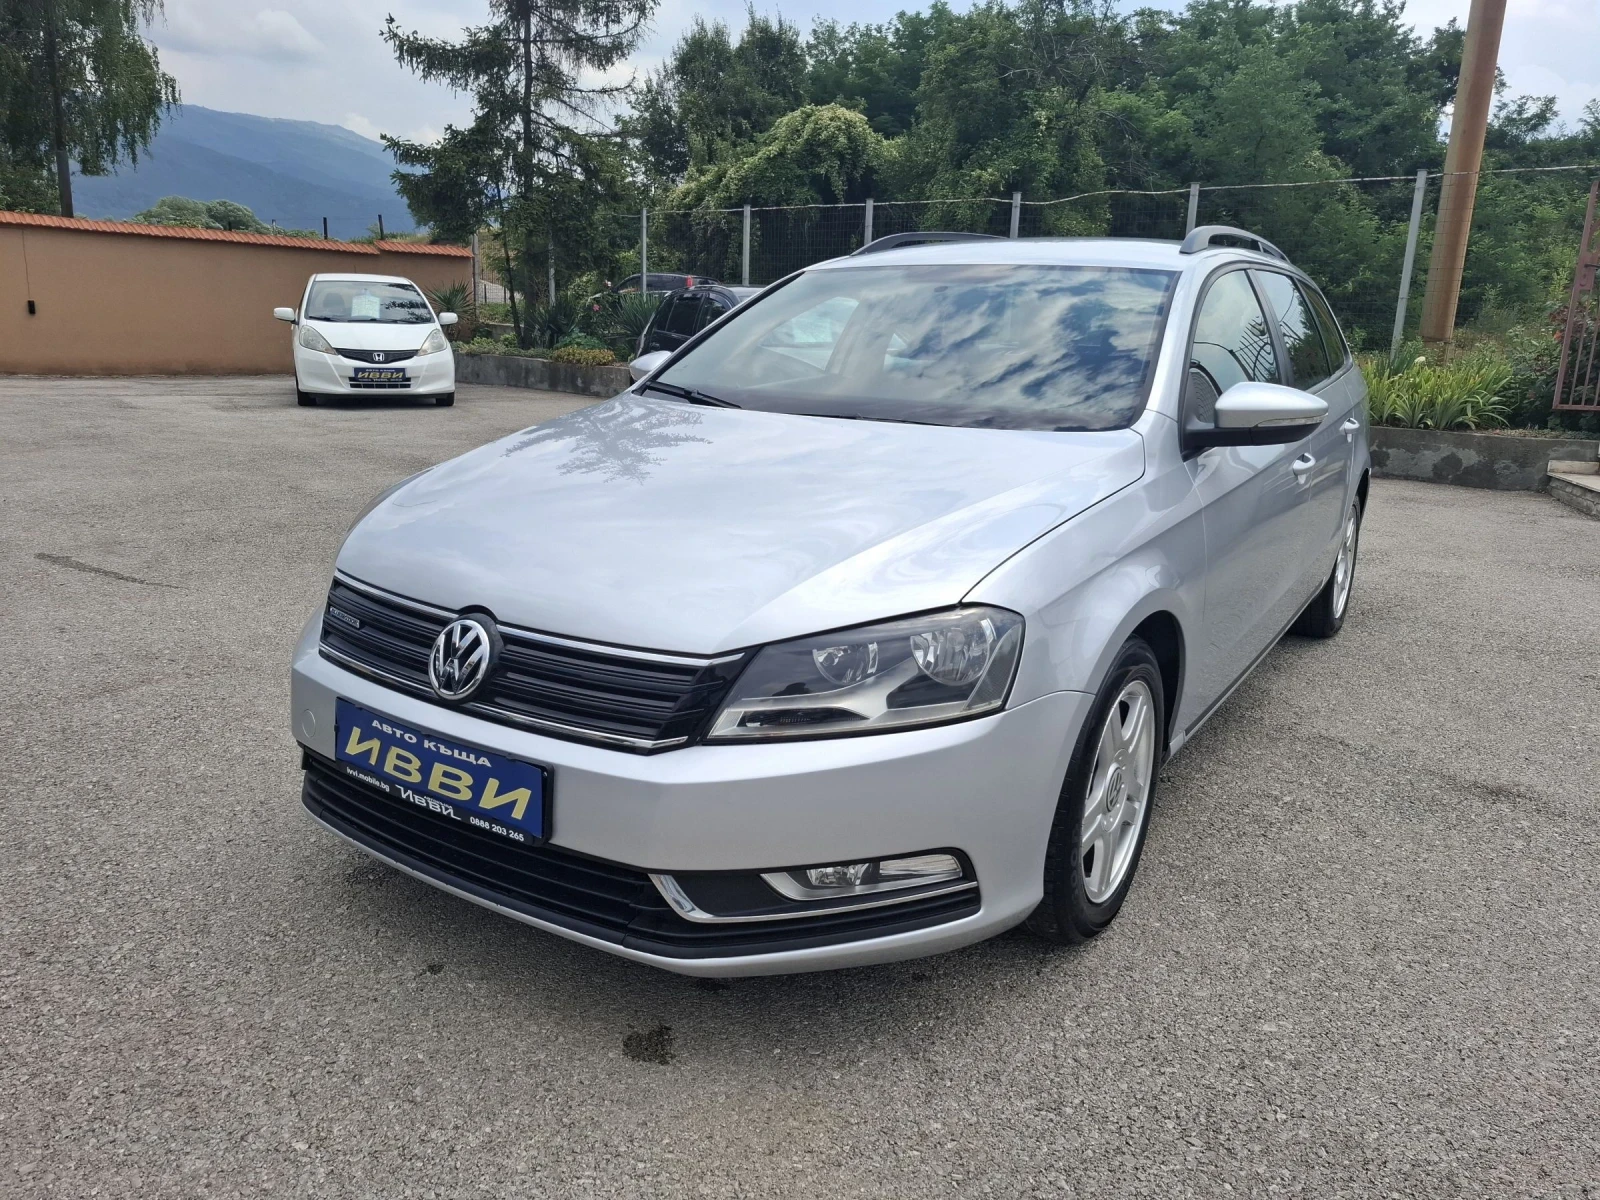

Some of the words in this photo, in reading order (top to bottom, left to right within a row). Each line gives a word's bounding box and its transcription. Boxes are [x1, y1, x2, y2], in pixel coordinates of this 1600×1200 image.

[357, 371, 404, 379] ИВВИ
[371, 719, 417, 744] АВТО
[423, 739, 492, 767] КЪЩА
[344, 726, 532, 820] ИВВИ
[395, 784, 462, 820] ИВВИ
[469, 816, 490, 830] 0888
[491, 824, 507, 836] 203
[508, 830, 525, 842] 265
